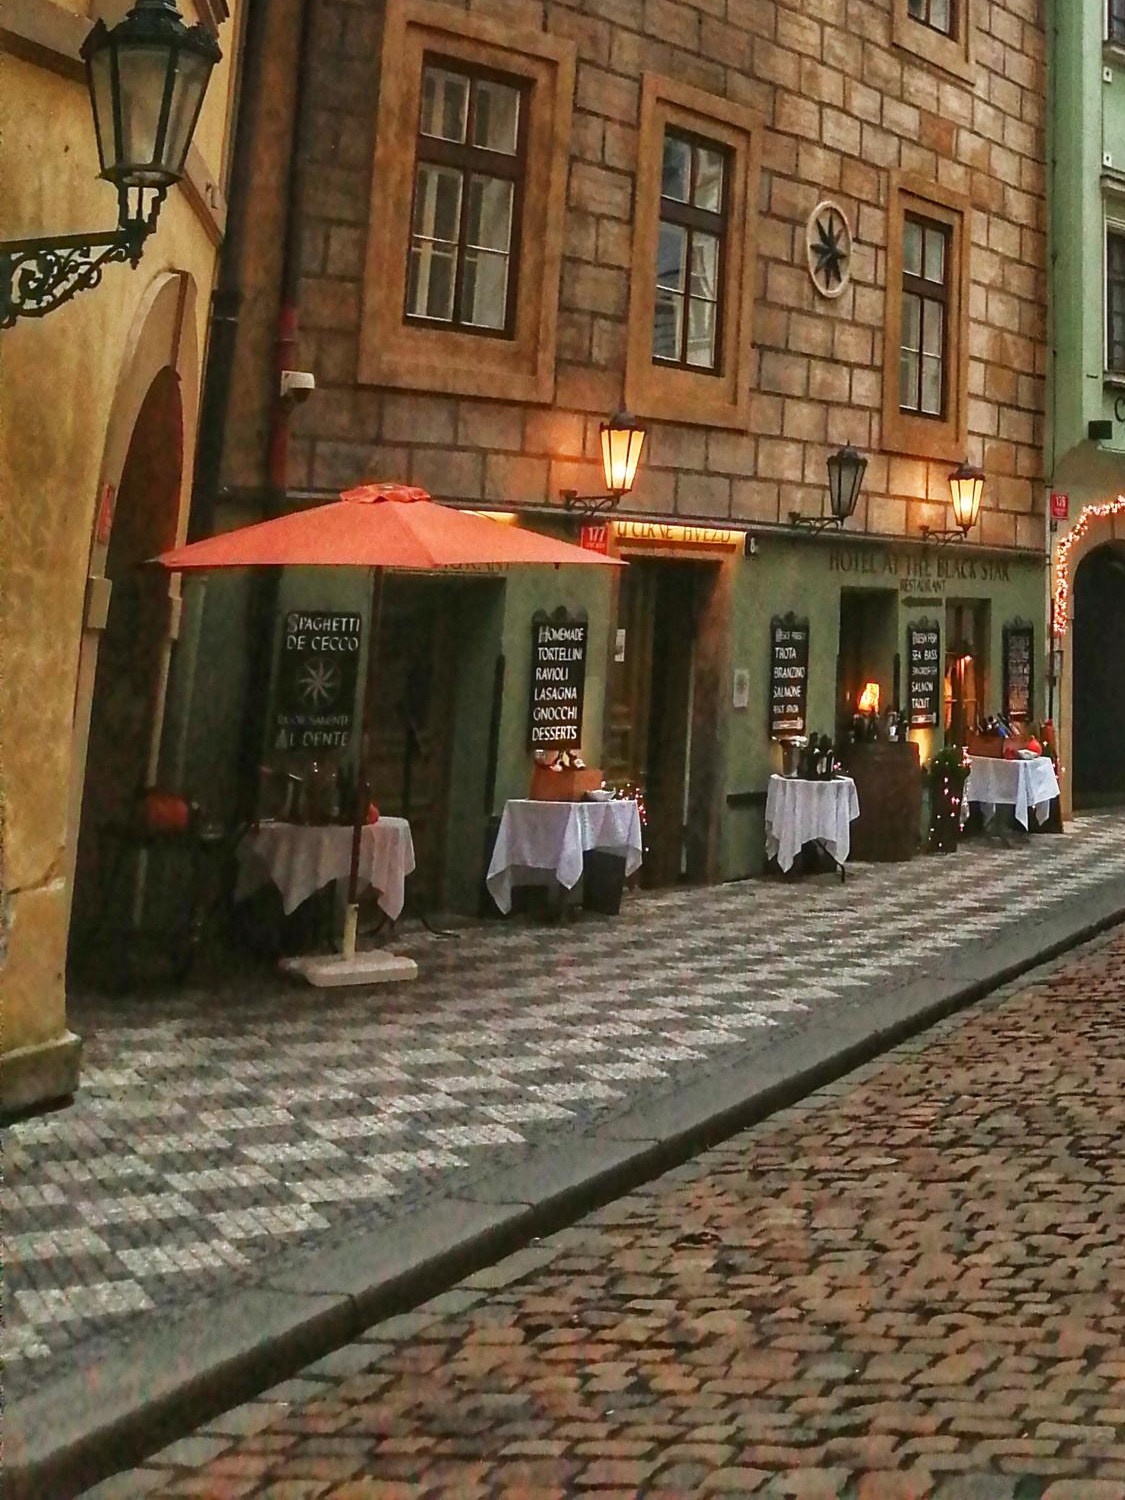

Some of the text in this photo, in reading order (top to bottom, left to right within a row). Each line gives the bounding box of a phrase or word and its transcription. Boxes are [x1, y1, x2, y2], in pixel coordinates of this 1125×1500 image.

[588, 526, 606, 543] 177
[829, 549, 1010, 582] HOTEL AT THE BLACK STAR
[900, 578, 946, 593] RESTAURANT
[287, 613, 360, 633] SPAGHETTI
[538, 625, 584, 643] HOMEMADE
[286, 635, 359, 651] DE CECCO
[538, 647, 583, 661] TORTELLINI
[775, 647, 797, 660] TROTA
[924, 649, 938, 660] BASS
[535, 667, 569, 681] RAVIOLI
[534, 687, 578, 701] LASAGNA
[773, 685, 802, 699] SALMONE
[911, 681, 934, 692] SALMON
[533, 706, 578, 721] GNOCCHI
[303, 731, 350, 747] DENTE
[532, 726, 578, 741] DESSERTS
